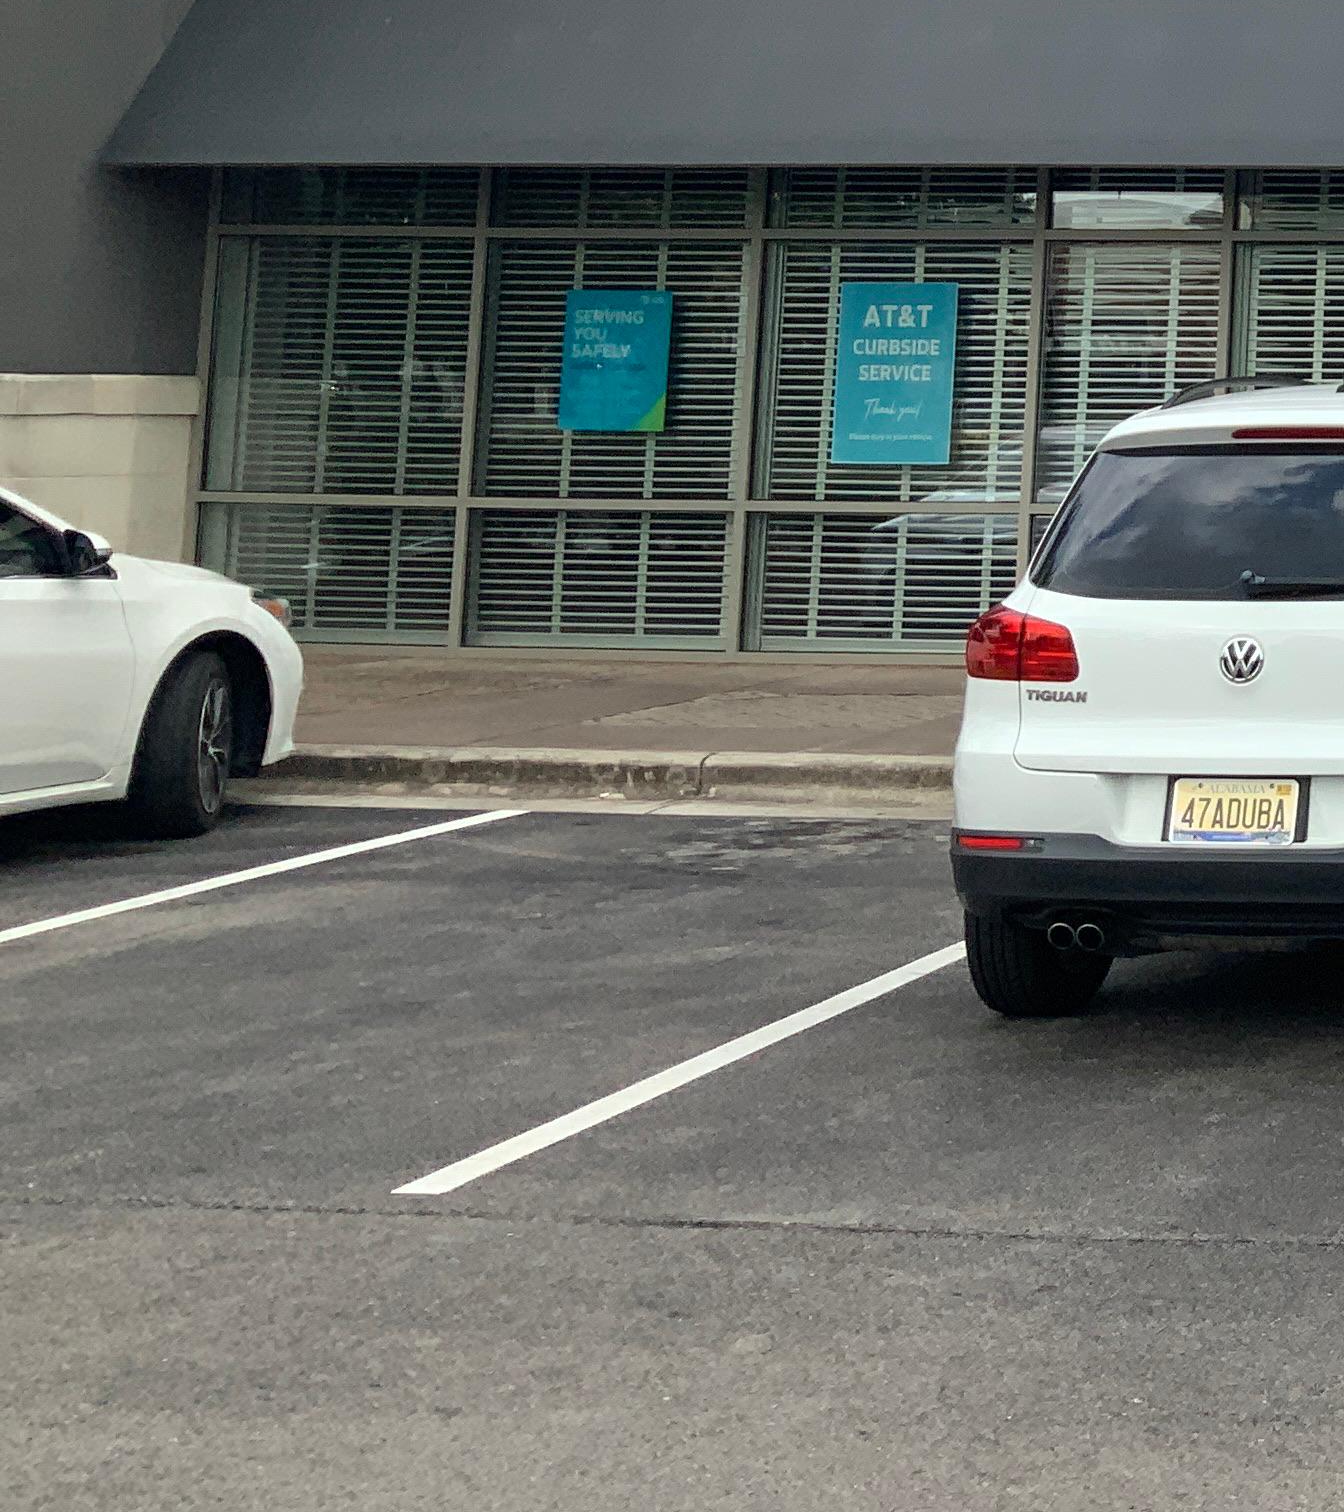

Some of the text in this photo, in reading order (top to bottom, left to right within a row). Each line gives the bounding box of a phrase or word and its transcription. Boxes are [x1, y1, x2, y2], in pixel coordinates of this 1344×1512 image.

[574, 309, 645, 325] SERVING
[862, 304, 934, 328] AT&T
[574, 327, 608, 341] YOU
[571, 343, 632, 359] SAFELY
[853, 338, 940, 356] CURBSIDE
[858, 364, 932, 382] SERVICE
[863, 397, 897, 422] Thank
[1221, 635, 1263, 682] VW
[1026, 689, 1088, 703] TIGUAN
[1180, 797, 1286, 830] 47ADUBA
